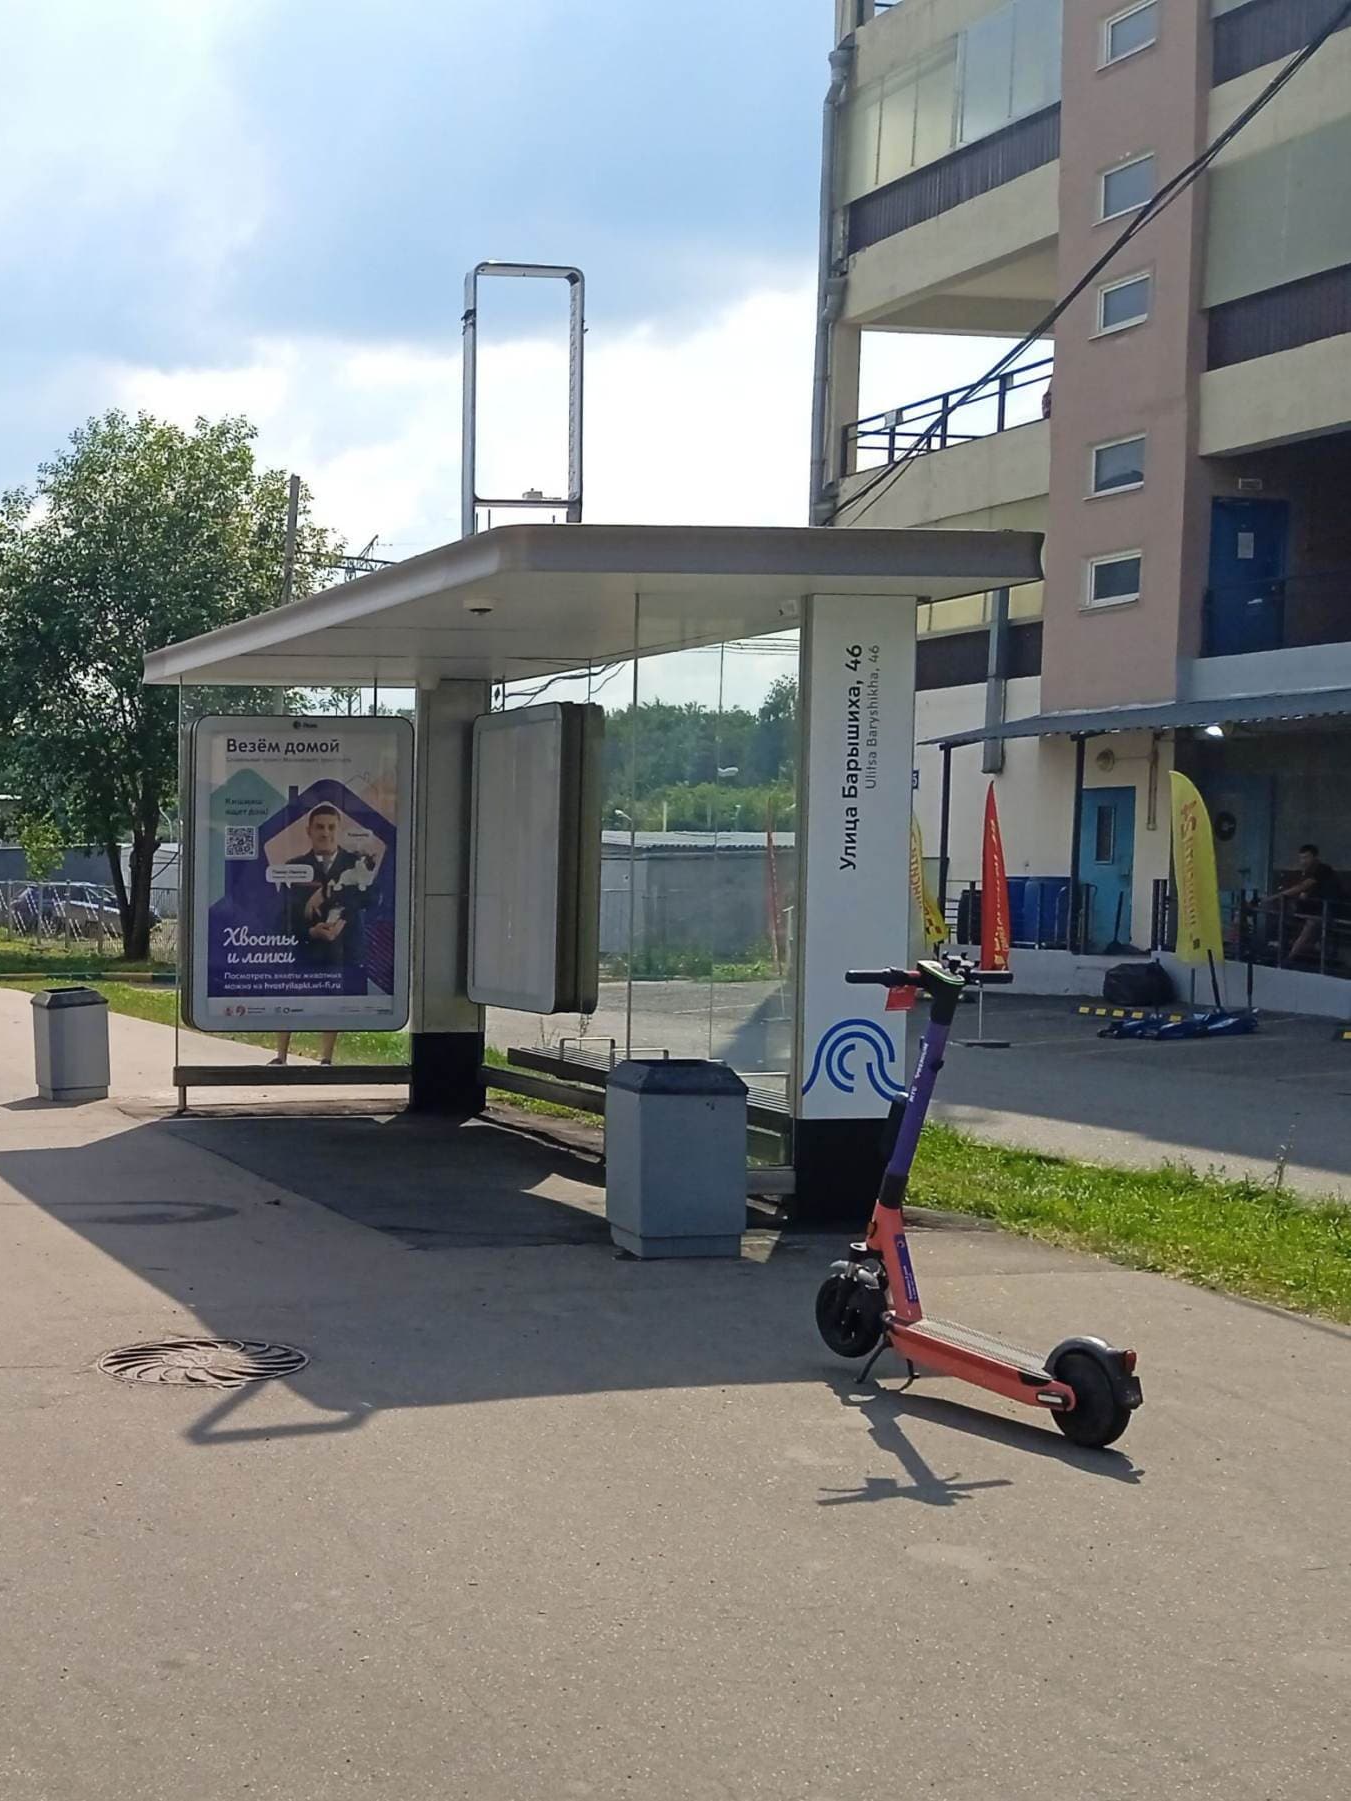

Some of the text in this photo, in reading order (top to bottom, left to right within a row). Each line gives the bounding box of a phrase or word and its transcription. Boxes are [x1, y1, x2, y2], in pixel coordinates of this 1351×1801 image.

[865, 645, 880, 789] Ulitsa Baryshikha, 46
[227, 738, 340, 755] Везём домой
[840, 645, 864, 870] Улица Барышиха, 46
[223, 926, 299, 946] Хвосты
[227, 952, 295, 964] и лапки
[224, 972, 272, 982] Посмотреть
